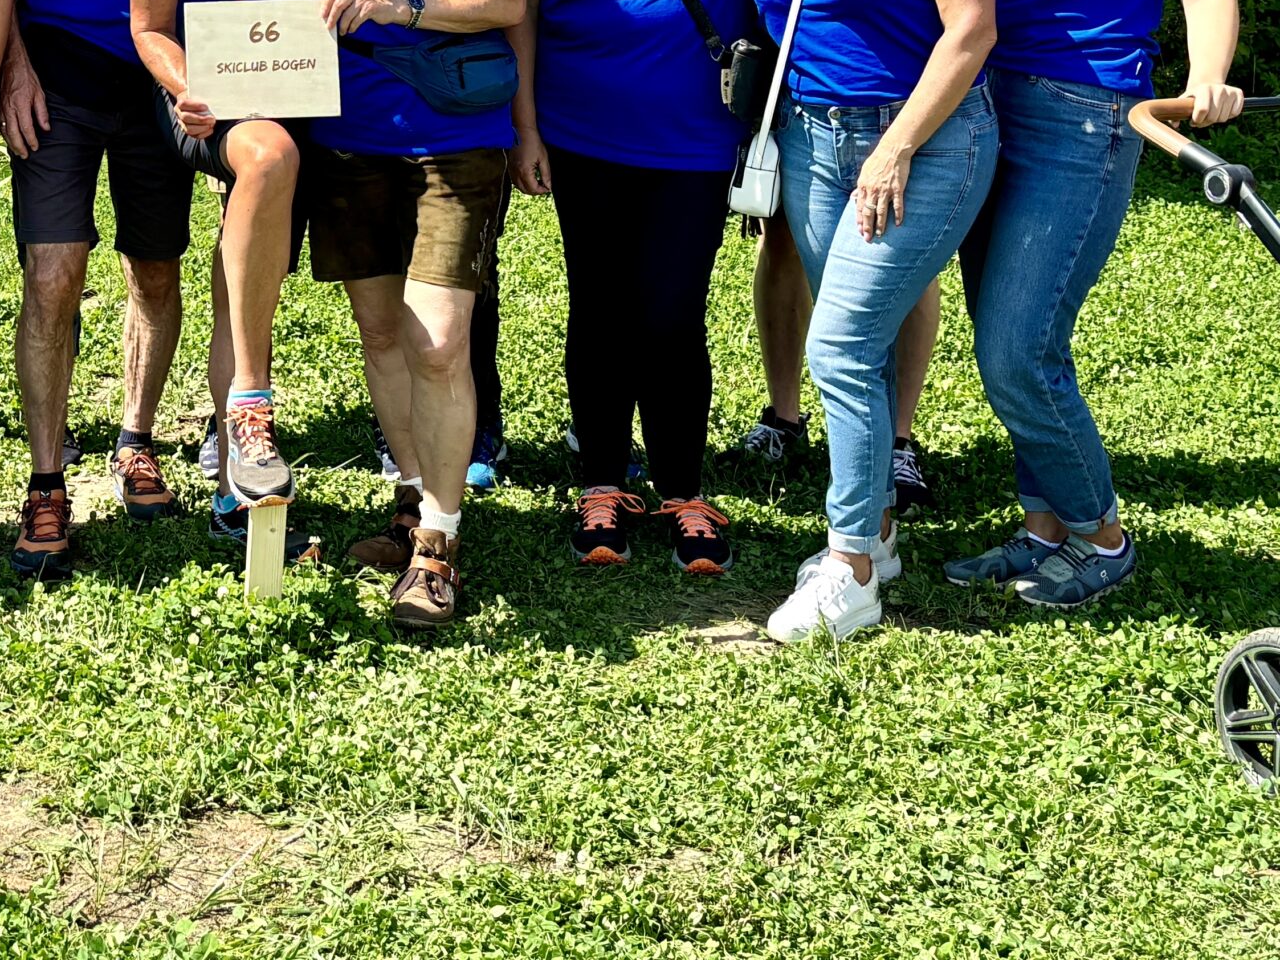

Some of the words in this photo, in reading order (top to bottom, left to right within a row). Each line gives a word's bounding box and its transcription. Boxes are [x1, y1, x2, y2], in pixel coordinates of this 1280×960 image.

[249, 21, 280, 43] 66
[216, 61, 268, 74] SKICLUB
[272, 58, 316, 72] BOGEN
